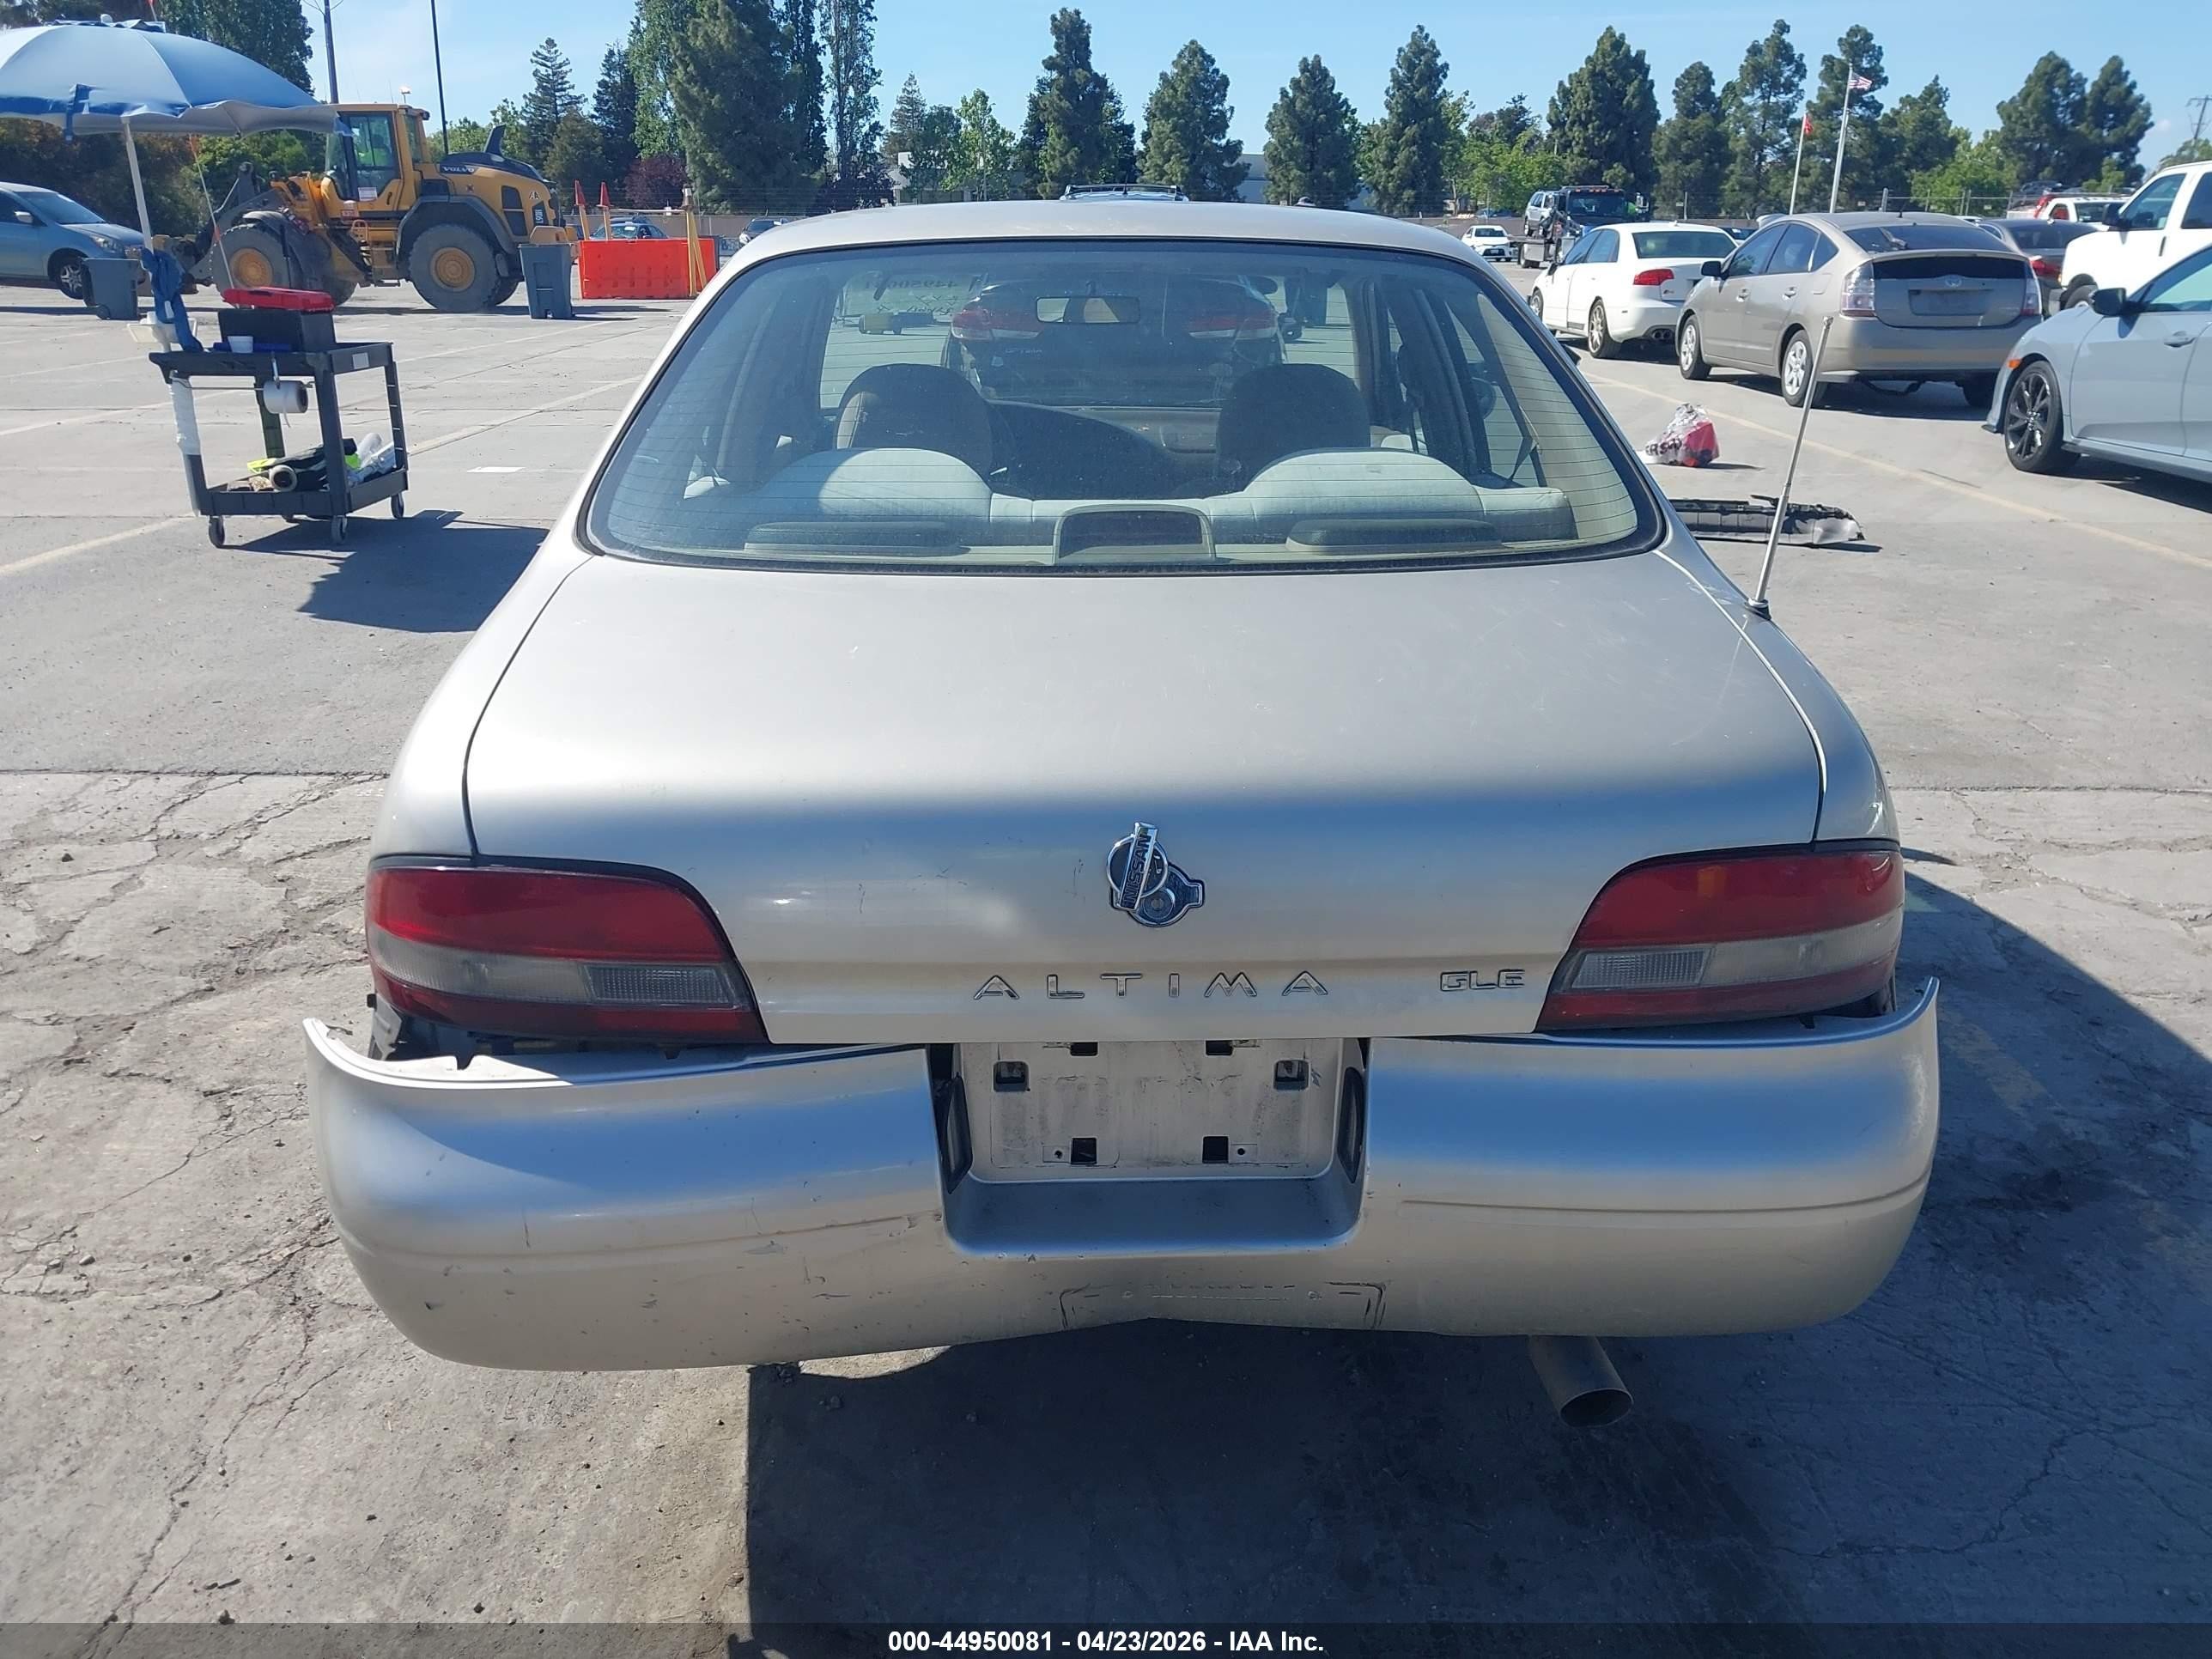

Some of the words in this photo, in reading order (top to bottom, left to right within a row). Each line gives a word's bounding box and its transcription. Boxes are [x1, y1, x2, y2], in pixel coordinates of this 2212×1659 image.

[1121, 832, 1153, 908] NISSAN
[973, 971, 1329, 1000] ALTIMA
[1440, 969, 1525, 992] GLE
